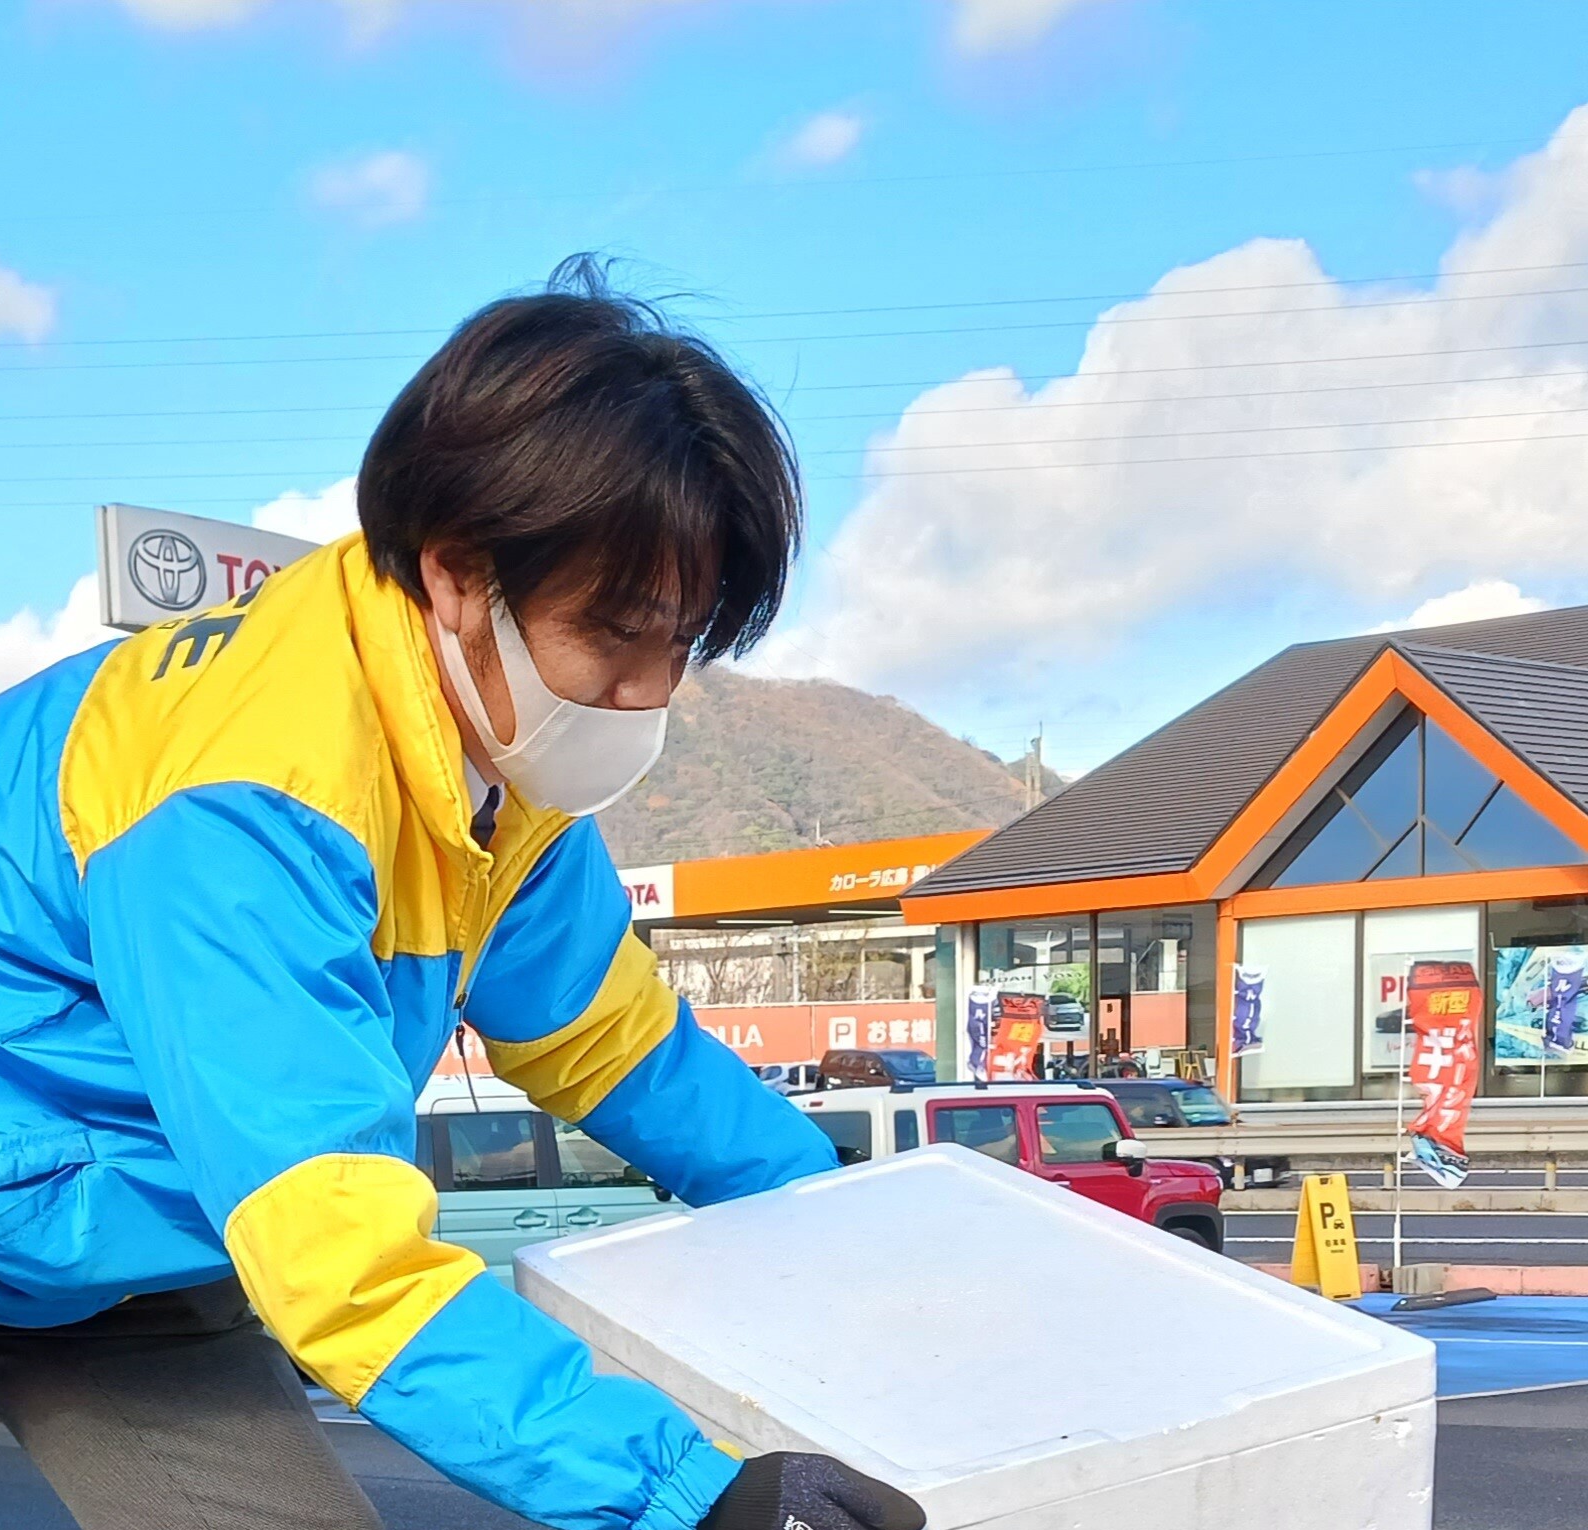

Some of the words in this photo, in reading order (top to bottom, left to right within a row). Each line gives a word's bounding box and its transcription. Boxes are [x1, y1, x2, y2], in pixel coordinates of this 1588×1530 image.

[216, 553, 282, 602] TO
[828, 866, 909, 892] カローラ広島
[1428, 991, 1471, 1016] 新型
[867, 1019, 936, 1044] お客様
[1319, 1202, 1335, 1230] P
